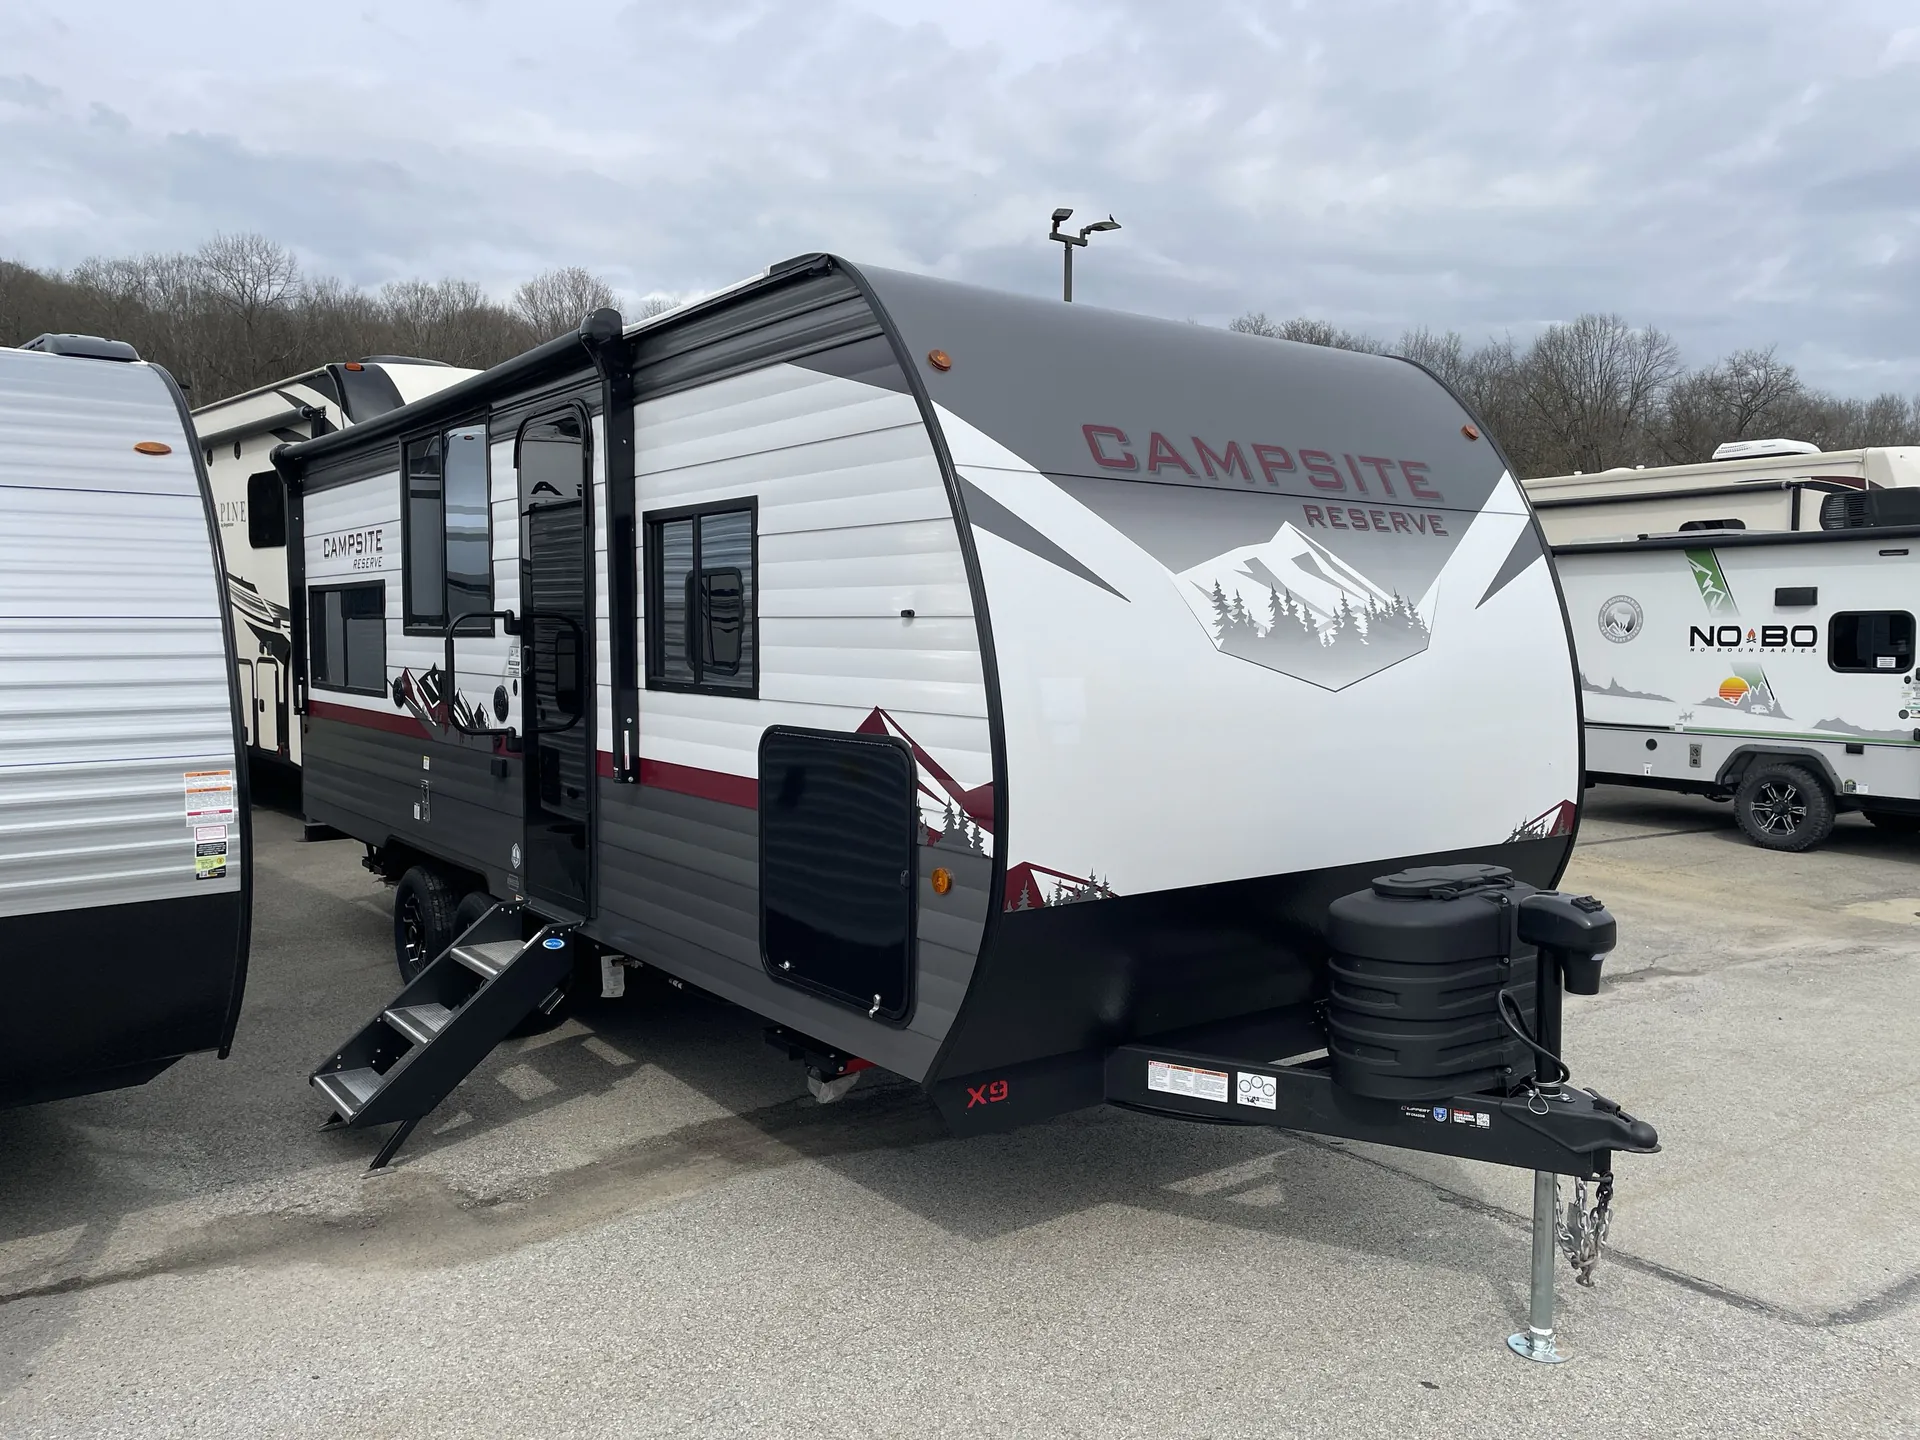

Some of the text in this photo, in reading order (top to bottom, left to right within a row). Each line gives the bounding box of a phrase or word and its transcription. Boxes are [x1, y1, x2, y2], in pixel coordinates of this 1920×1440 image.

[1081, 423, 1444, 500] CAMPSITE
[219, 501, 246, 522] PINE
[1302, 504, 1449, 537] RESERVE
[323, 529, 383, 558] CAMPSITE
[353, 556, 383, 570] RESERVE
[967, 1080, 1008, 1109] X9
